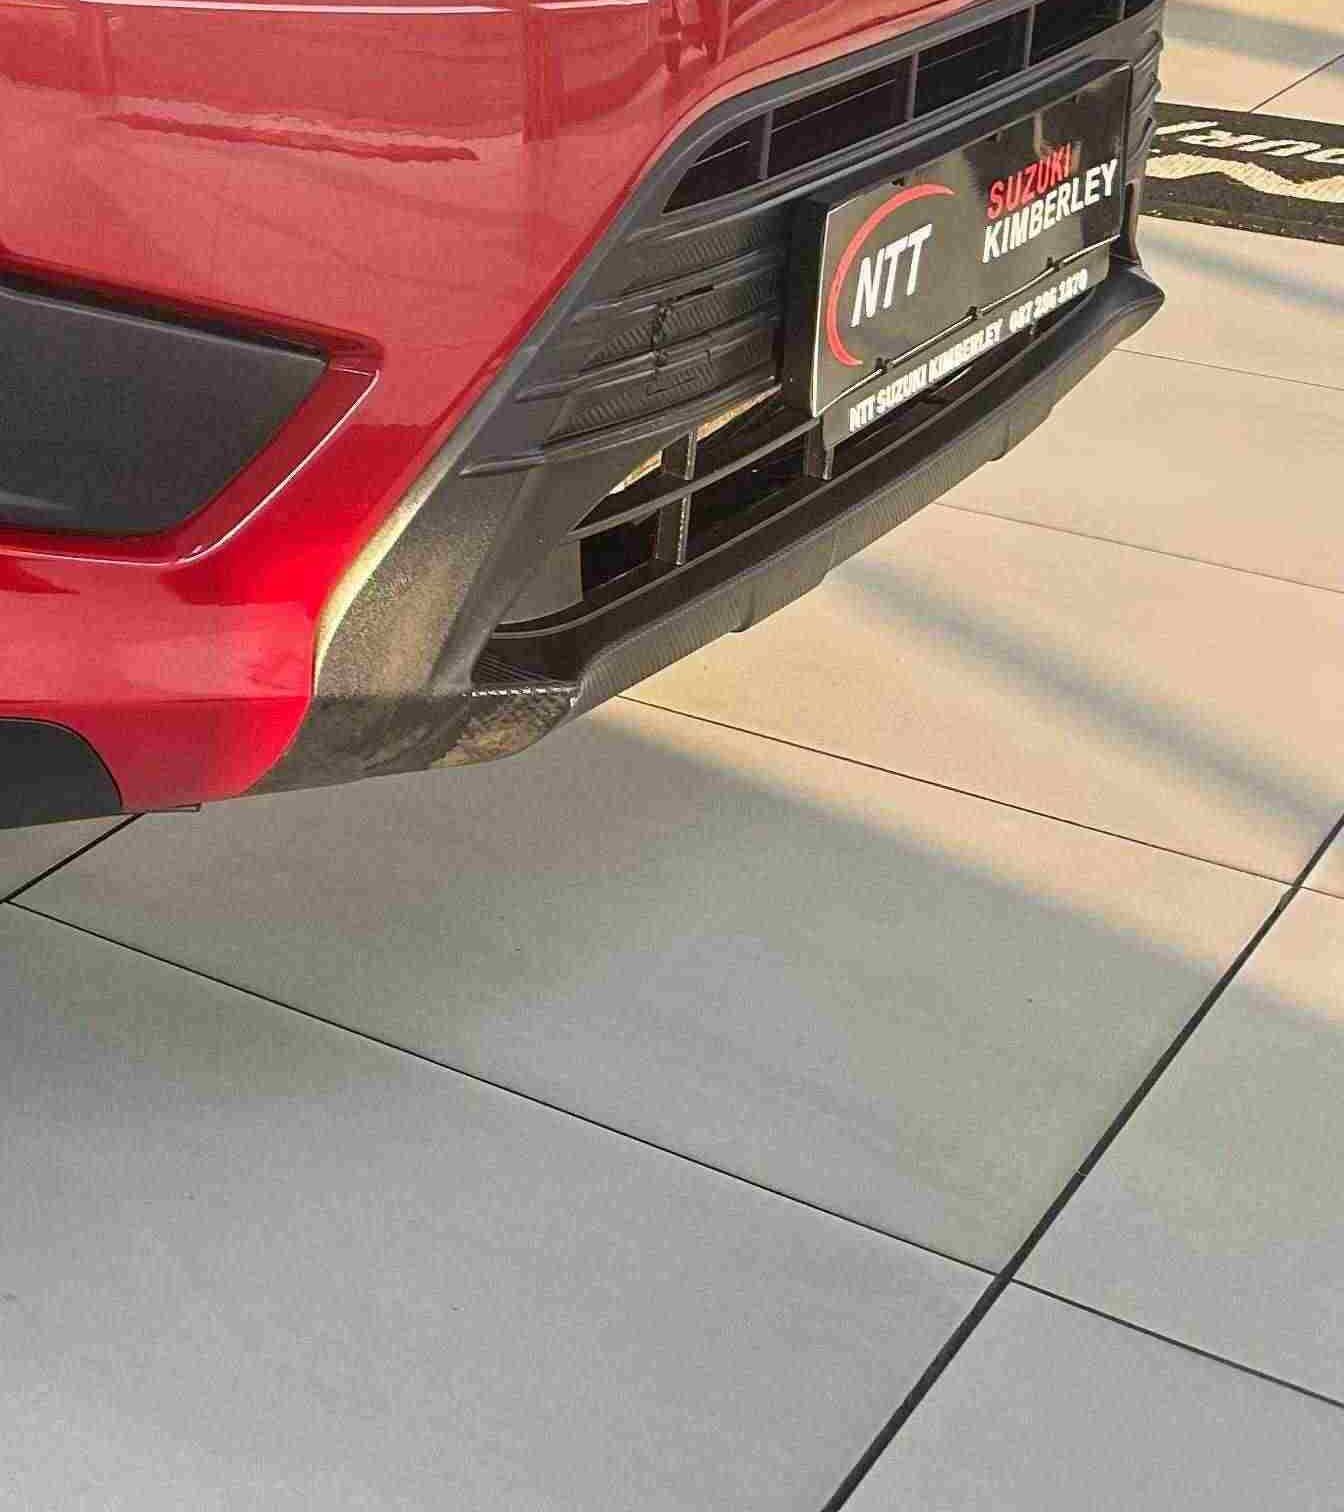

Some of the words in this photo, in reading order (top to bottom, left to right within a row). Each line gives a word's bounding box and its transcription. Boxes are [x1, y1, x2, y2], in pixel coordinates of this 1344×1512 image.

[983, 159, 1118, 263] KIMBERLEY
[986, 142, 1072, 220] SUZUKI
[850, 223, 934, 329] NTT
[848, 400, 875, 433] NTT
[876, 364, 929, 413] SUZUKI
[928, 319, 1004, 385] KIMBERLEY
